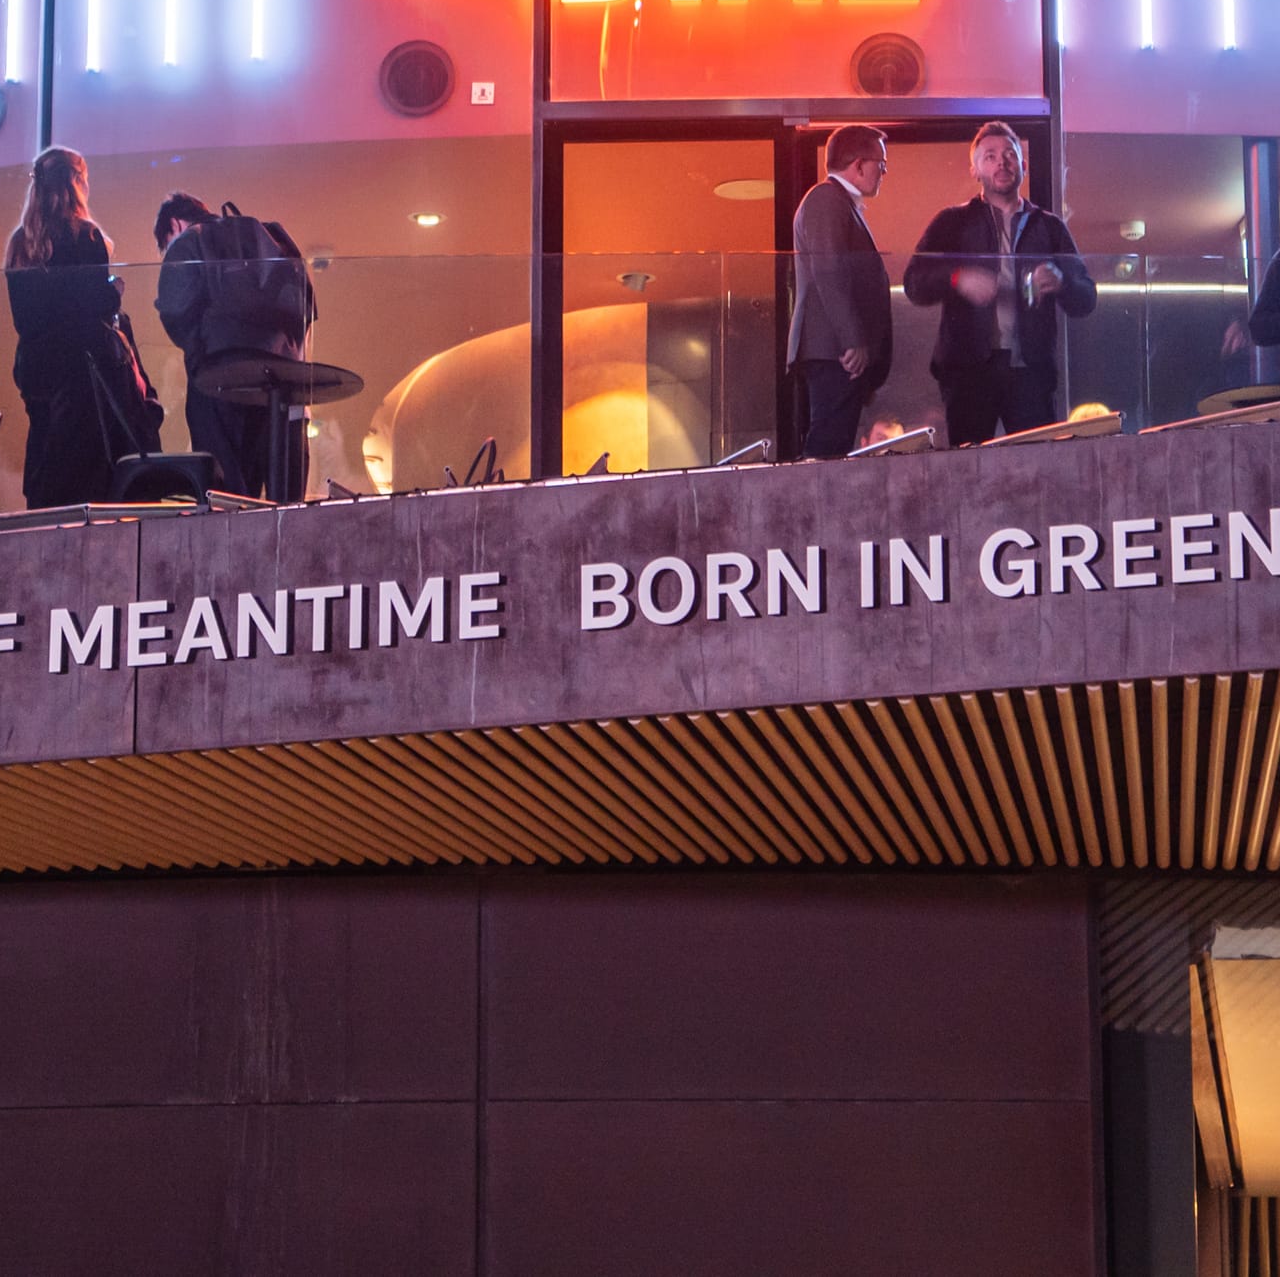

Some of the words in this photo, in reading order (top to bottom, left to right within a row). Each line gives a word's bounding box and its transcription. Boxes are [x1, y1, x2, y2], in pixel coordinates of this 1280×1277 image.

[47, 570, 504, 674] MEANTIME
[579, 545, 823, 631] BORN
[858, 534, 945, 610] IN
